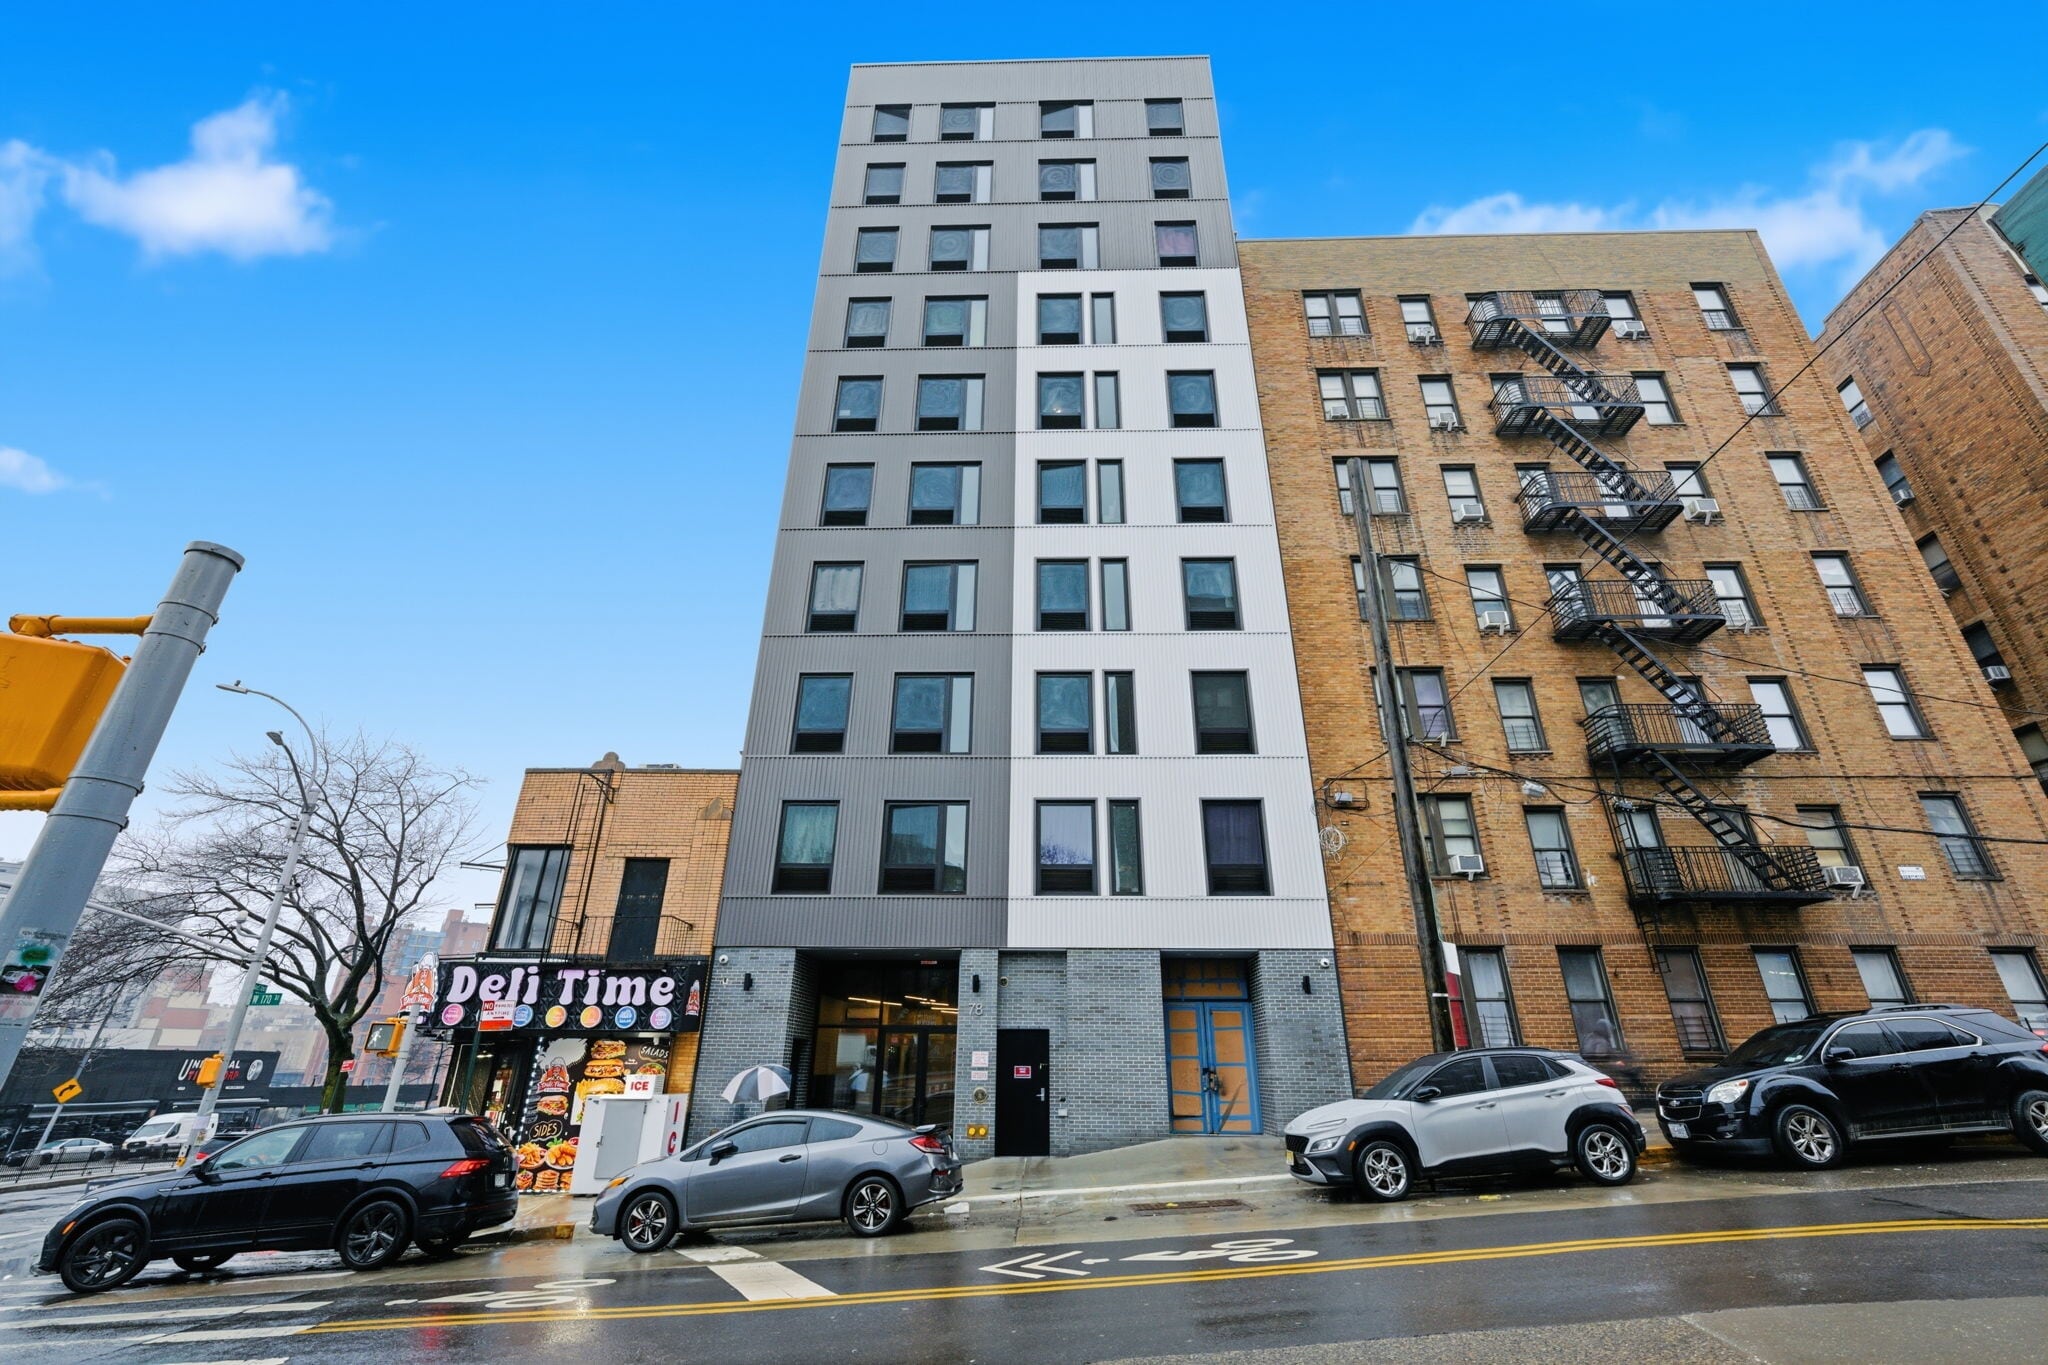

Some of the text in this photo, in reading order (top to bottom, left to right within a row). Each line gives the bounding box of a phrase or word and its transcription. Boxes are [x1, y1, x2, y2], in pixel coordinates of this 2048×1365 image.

[446, 965, 676, 1006] Deli Time
[484, 1001, 494, 1010] NO
[968, 1002, 983, 1016] 78
[640, 1045, 669, 1058] SALADS
[630, 1081, 649, 1091] ICE
[532, 1122, 558, 1138] SIDES
